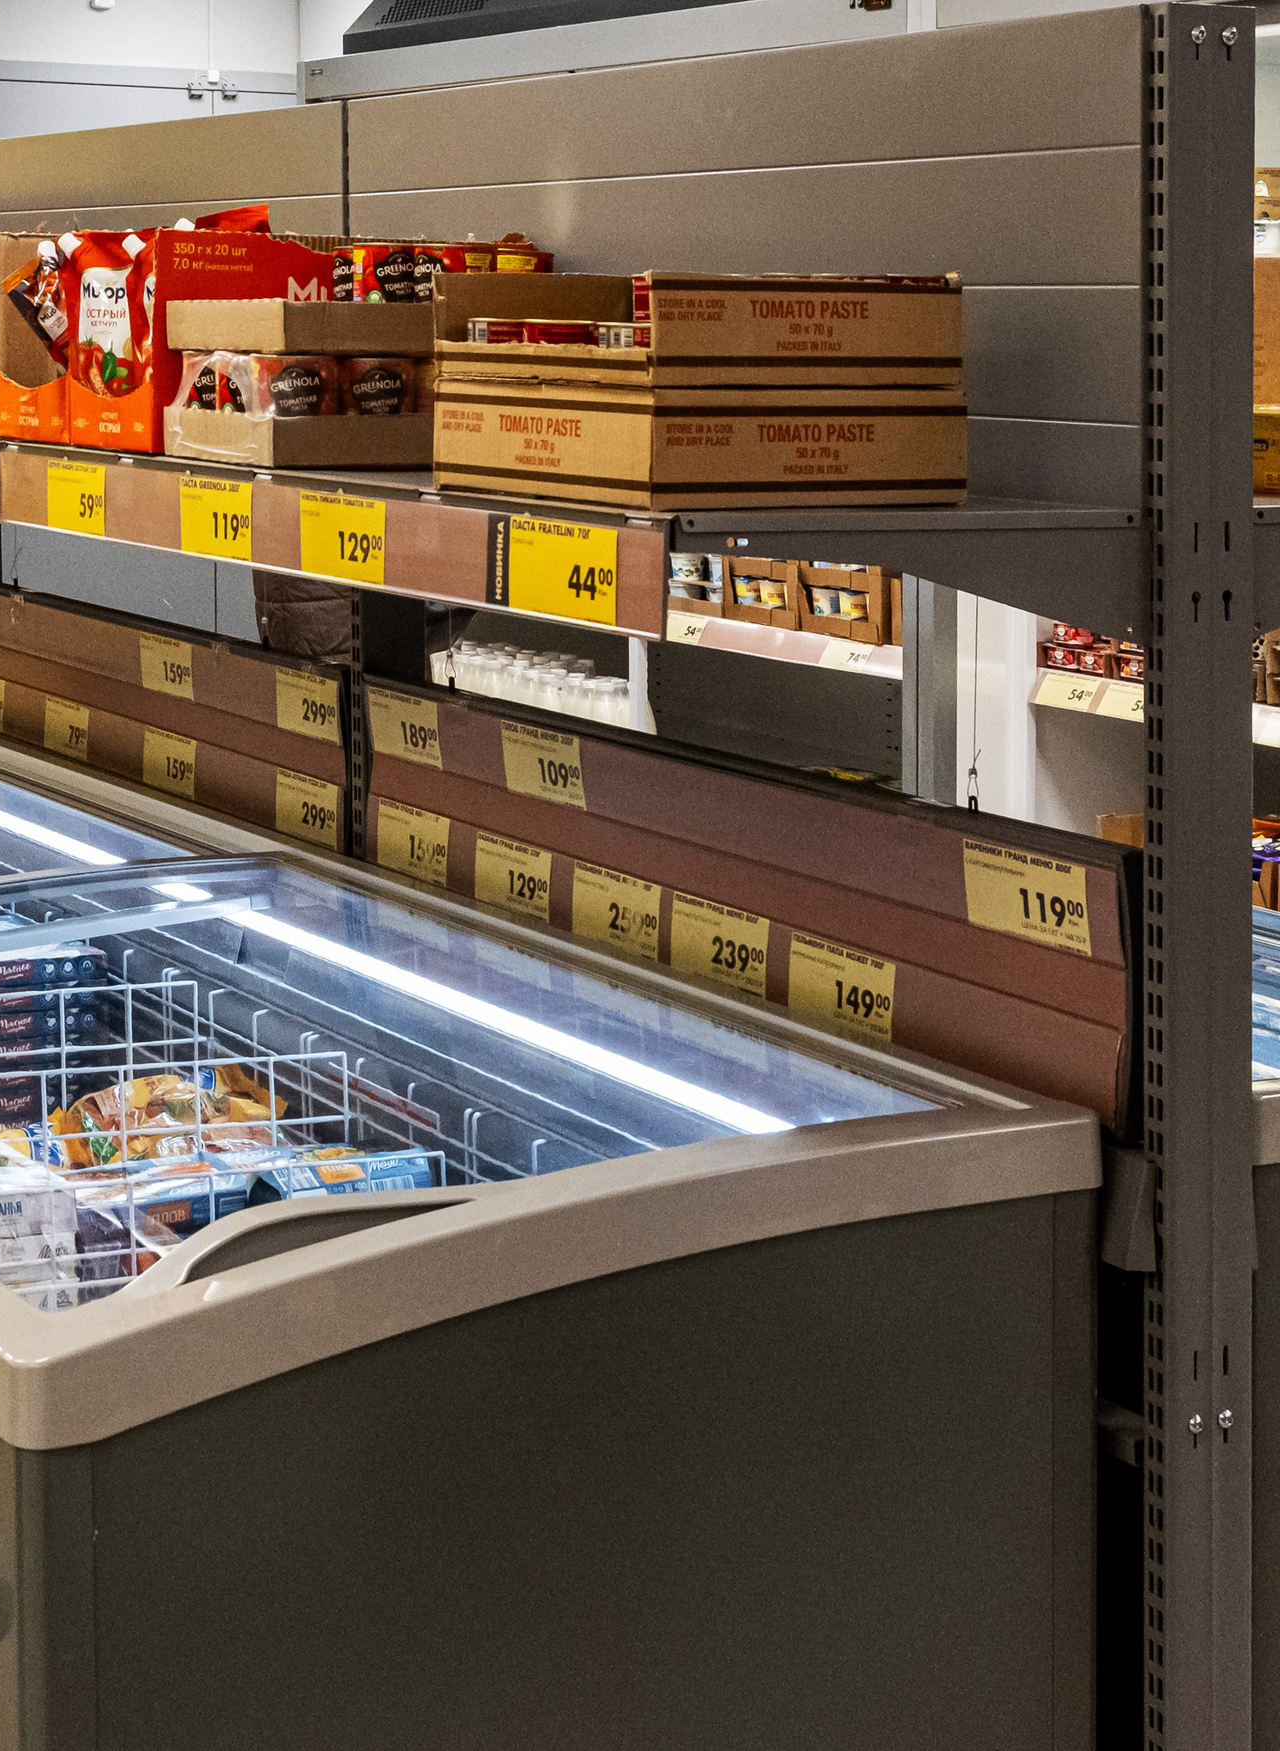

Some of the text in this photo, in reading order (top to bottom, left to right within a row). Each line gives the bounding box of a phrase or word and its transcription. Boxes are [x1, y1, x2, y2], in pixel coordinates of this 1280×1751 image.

[173, 242, 195, 254] 350
[215, 244, 229, 255] 20
[232, 247, 247, 256] шт
[173, 258, 189, 270] 7,0
[192, 261, 203, 269] кг
[87, 308, 126, 318] ОСТРЫЙ
[705, 300, 727, 309] COOL
[750, 300, 869, 319] TOMATO PASTE
[270, 372, 320, 392] GREENOLA
[499, 414, 581, 437] TOMATO PASTE
[714, 424, 735, 434] COOL
[757, 424, 875, 443] TOMATO PASTE
[199, 480, 226, 491] GREENOLA
[80, 493, 94, 518] 59
[213, 512, 239, 541] 119
[512, 519, 536, 532] ПАСТА
[538, 523, 574, 537] FRATELINI
[338, 530, 370, 563] 129
[495, 522, 504, 600] НОВИНКА
[568, 564, 597, 601] 44
[684, 625, 696, 636] 54
[848, 652, 860, 663] 74
[163, 661, 183, 685] 159
[1068, 688, 1084, 701] 54
[302, 698, 326, 726] 299
[401, 721, 427, 749] 189
[166, 756, 185, 781] 159
[538, 757, 568, 788] 109
[302, 801, 326, 830] 299
[964, 840, 1002, 857] ВАРЕНИКИ
[1004, 850, 1028, 865] ГРАНД
[1030, 856, 1053, 870] МЕНЮ
[509, 869, 536, 900] 129
[1019, 888, 1066, 928] 119
[711, 936, 750, 973] 239
[793, 933, 825, 950] ПЕЛЬМЕНИ
[826, 945, 844, 957] ПАПА
[846, 951, 868, 965] МОЖЕТ
[836, 979, 874, 1018] 149
